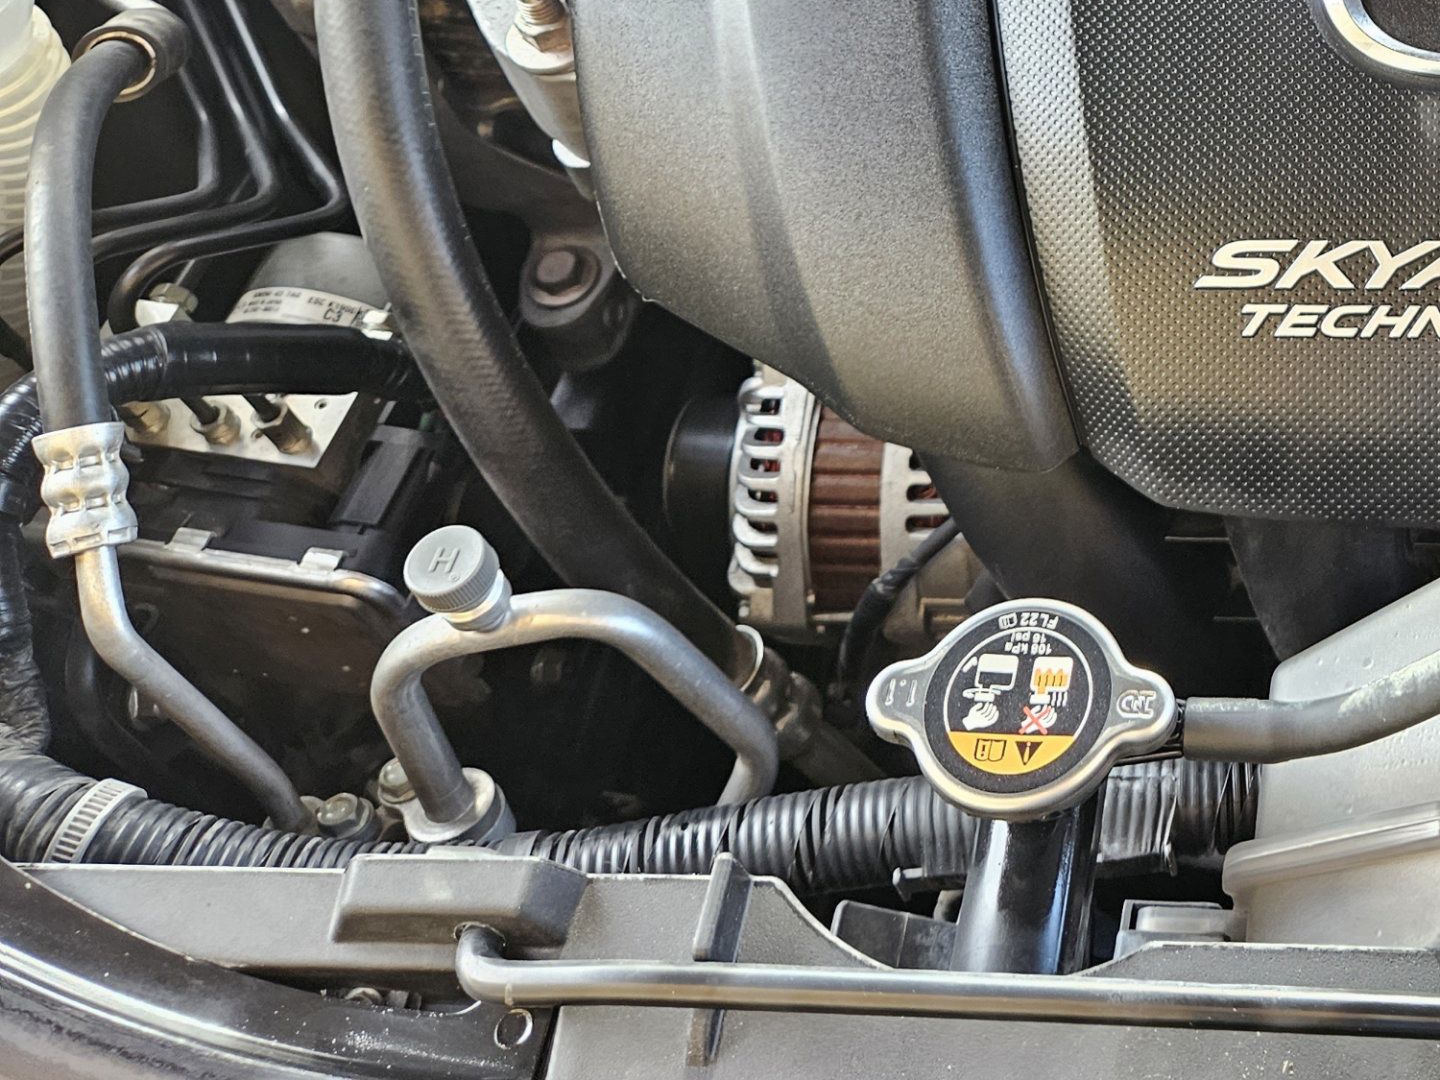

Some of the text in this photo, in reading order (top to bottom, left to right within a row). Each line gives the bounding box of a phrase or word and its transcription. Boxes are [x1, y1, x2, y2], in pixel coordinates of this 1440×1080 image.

[428, 546, 461, 574] H
[1020, 611, 1060, 630] FL22
[1004, 641, 1029, 655] kPa
